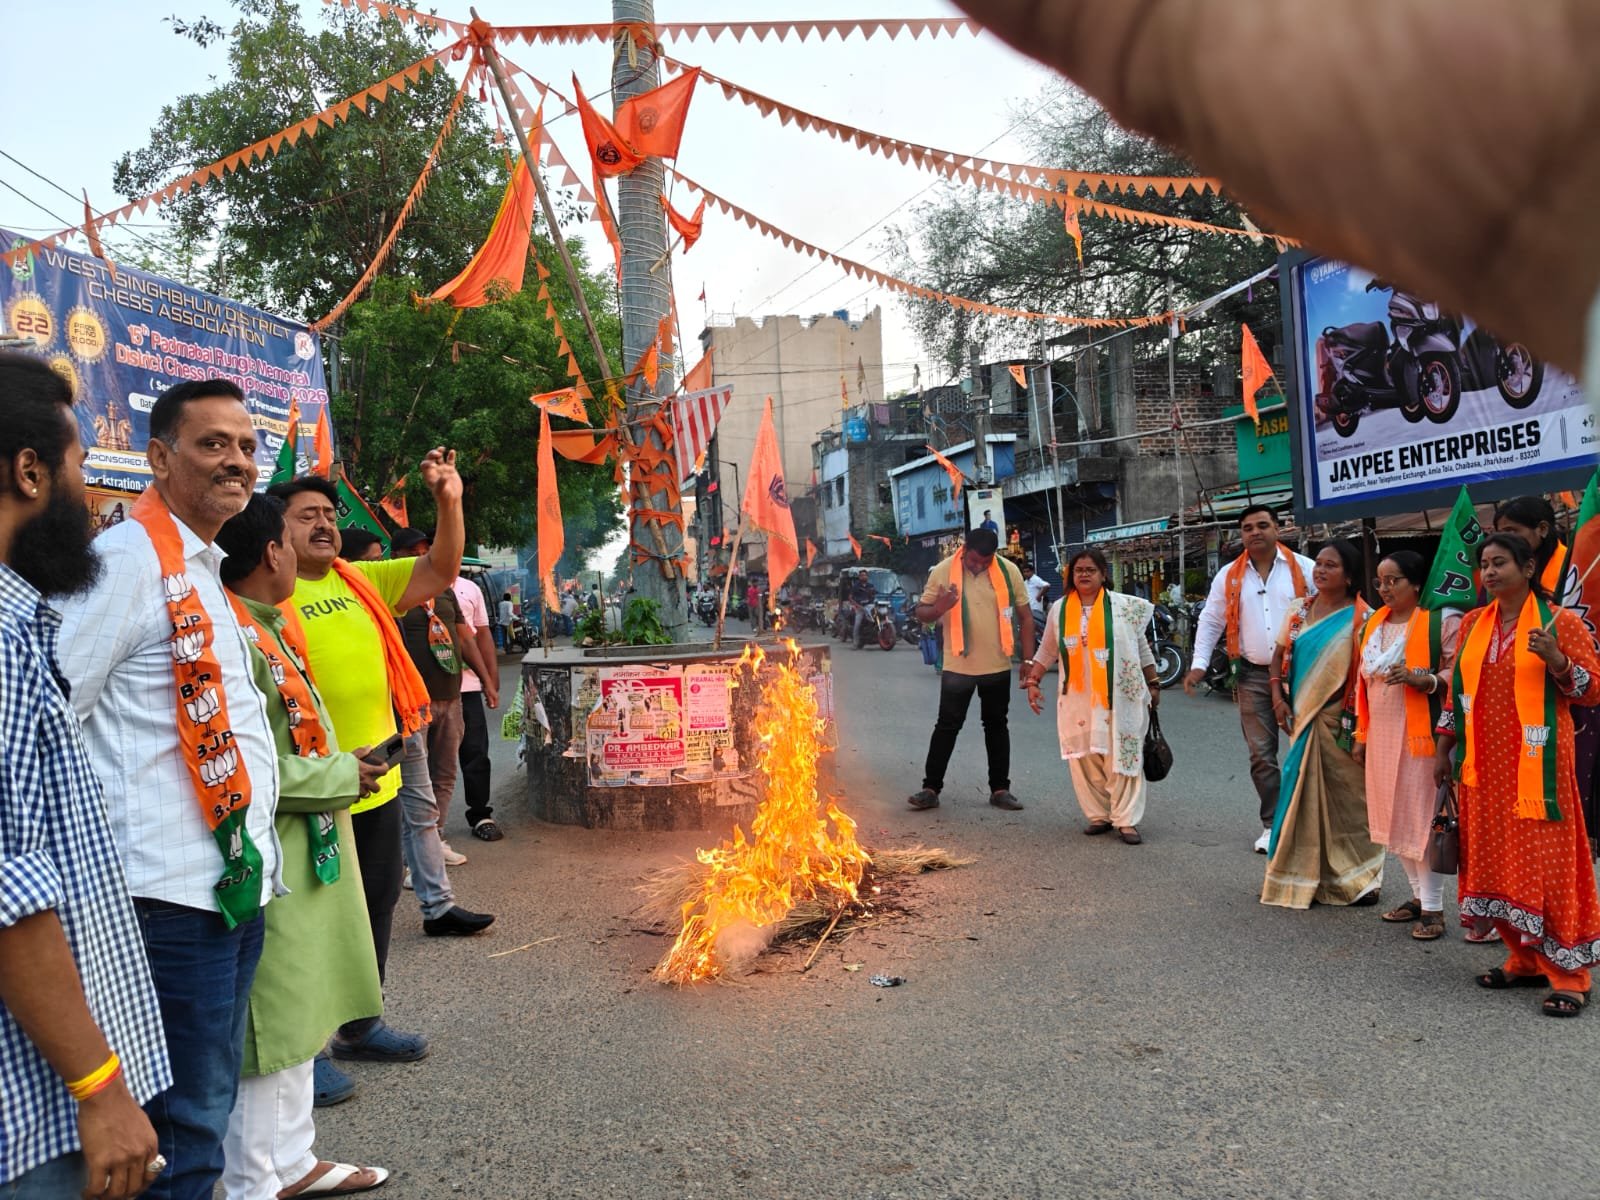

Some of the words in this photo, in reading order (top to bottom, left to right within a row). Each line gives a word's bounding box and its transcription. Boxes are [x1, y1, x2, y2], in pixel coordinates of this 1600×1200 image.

[44, 248, 109, 281] WEST
[114, 271, 222, 318] SINGHBHUM
[224, 306, 291, 340] DISTRICT
[88, 281, 154, 315] CHESS
[158, 303, 266, 348] ASSOCIATION
[16, 314, 49, 336] 22
[114, 342, 163, 373] District
[163, 355, 206, 382] Chess
[127, 323, 149, 347] 15th
[150, 331, 215, 365] Padmabai
[256, 358, 310, 386] Memorial
[1329, 450, 1395, 483] JAYPEE
[1399, 420, 1541, 470] ENTERPRISES
[607, 744, 624, 752] DR.
[625, 741, 681, 753] AMBEDKAR
[615, 751, 668, 759] TUTORIALS
